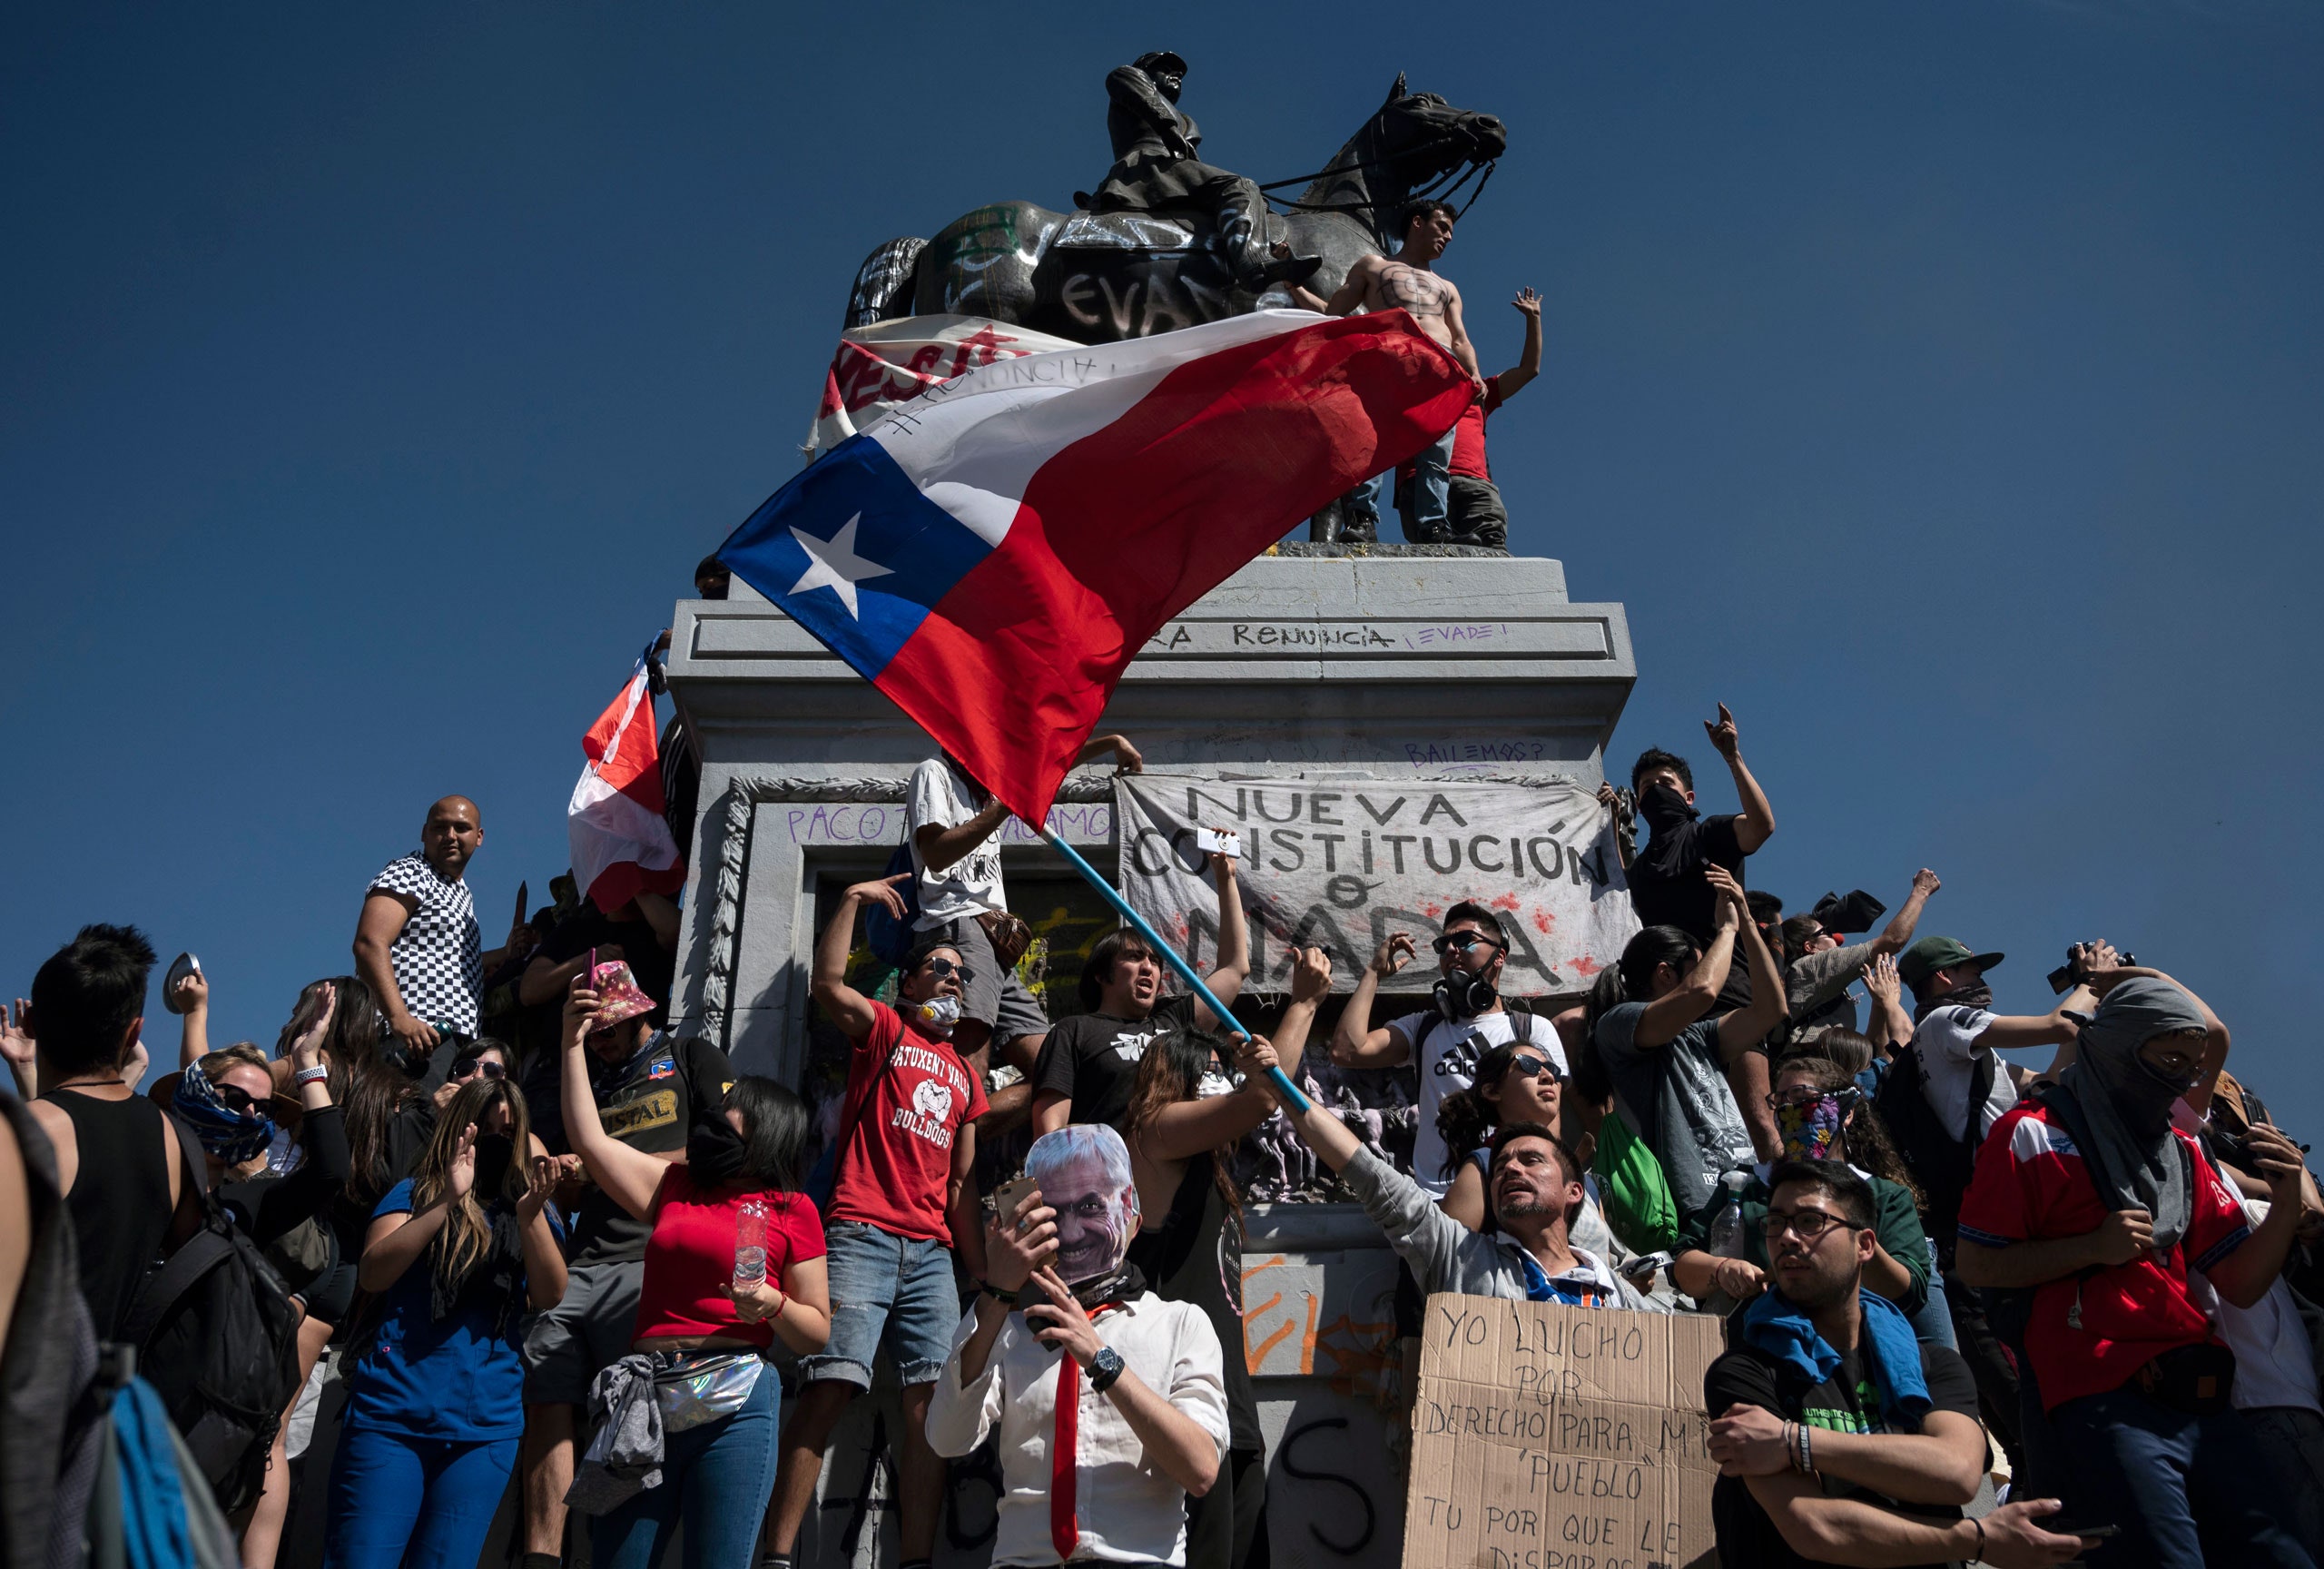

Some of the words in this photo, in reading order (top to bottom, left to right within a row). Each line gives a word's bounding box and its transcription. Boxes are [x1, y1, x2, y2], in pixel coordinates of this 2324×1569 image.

[788, 805, 886, 844] PACO
[1187, 786, 1469, 828] NUEVA
[891, 1107, 951, 1150] BULLDOGS
[2210, 1179, 2231, 1208] 23
[1440, 1307, 1487, 1348] YO
[1512, 1308, 1643, 1360] LUCHO
[1514, 1365, 1583, 1407] POR
[1425, 1401, 1545, 1438] DERECHO
[1559, 1413, 1633, 1452] PARA
[1423, 1496, 1462, 1531] TU
[1485, 1505, 1539, 1537] POR
[1561, 1514, 1619, 1545] QUE
[1640, 1519, 1682, 1555] LE
